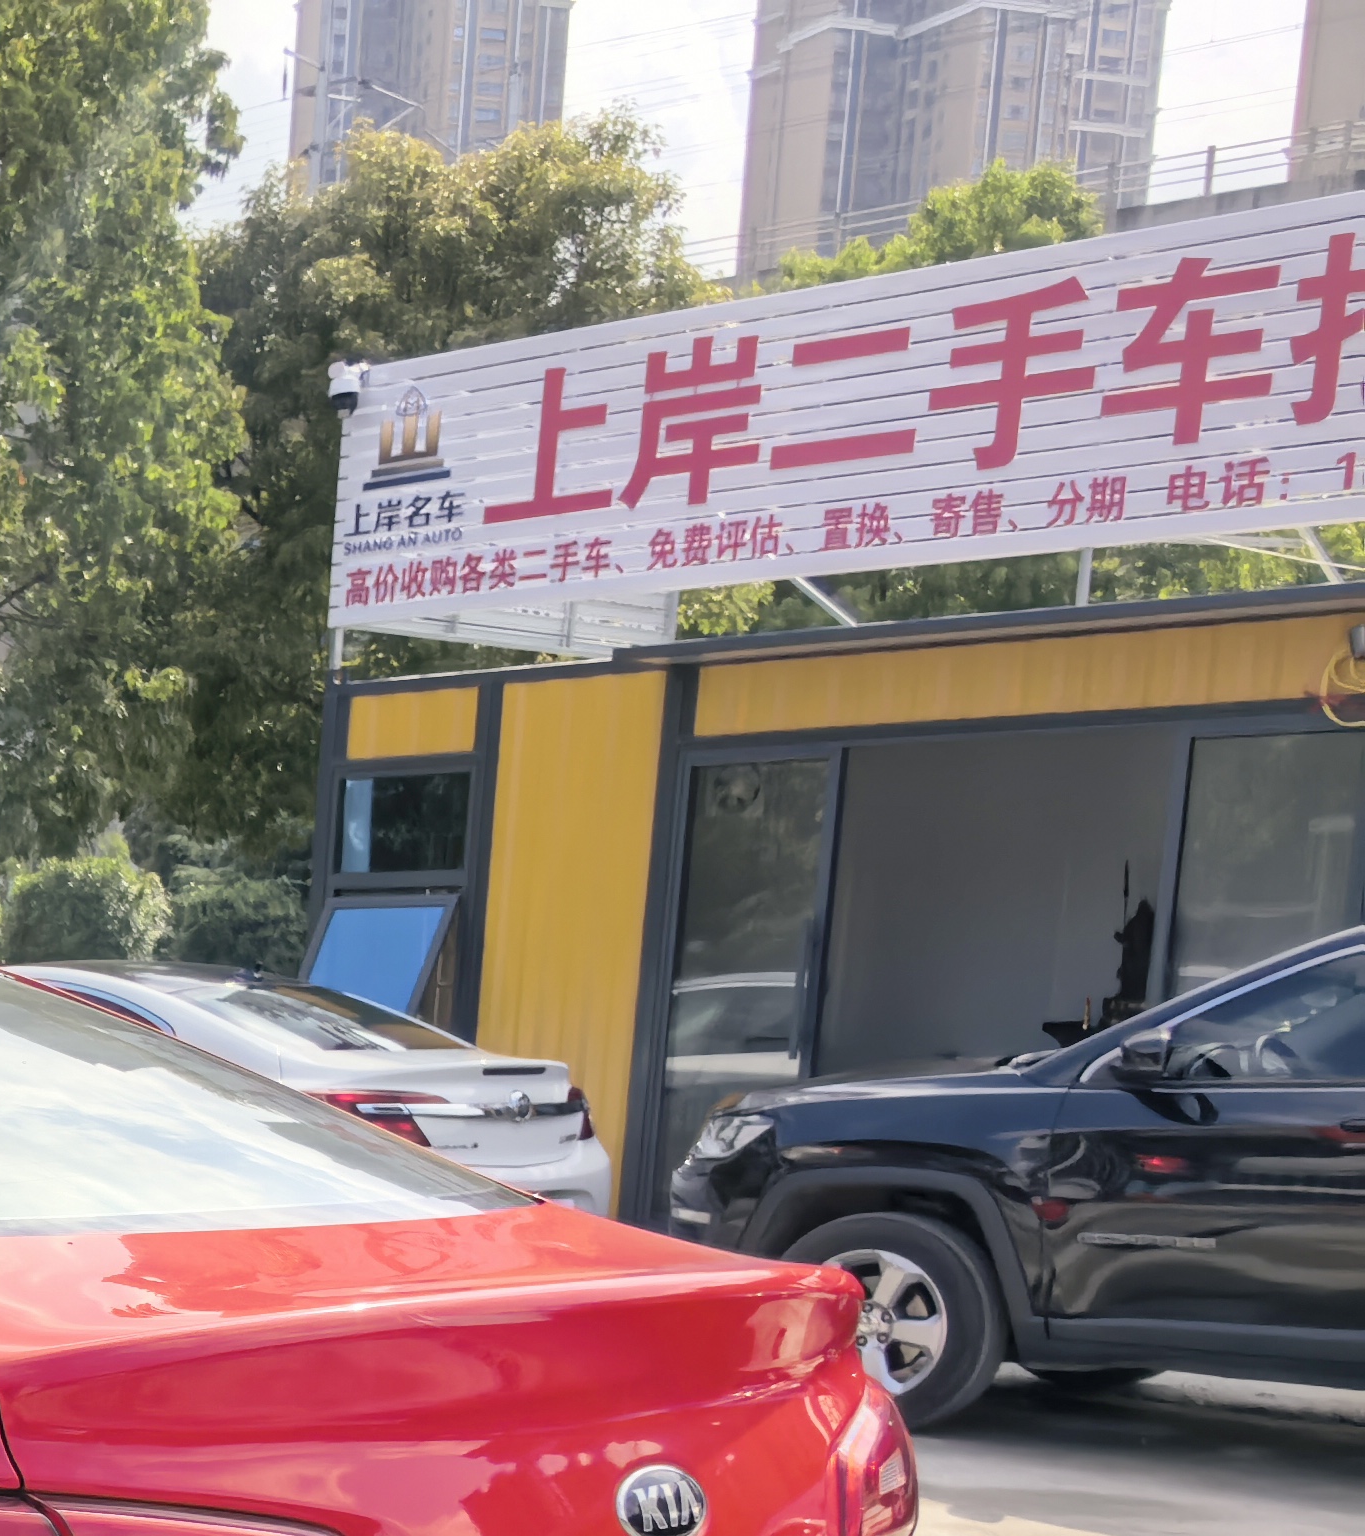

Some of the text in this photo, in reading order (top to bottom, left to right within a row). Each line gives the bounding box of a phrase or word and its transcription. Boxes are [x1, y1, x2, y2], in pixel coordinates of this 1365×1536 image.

[343, 490, 465, 537] 上岸名车
[343, 527, 463, 556] SHANG AN AUTO
[632, 1480, 702, 1532] KIA
